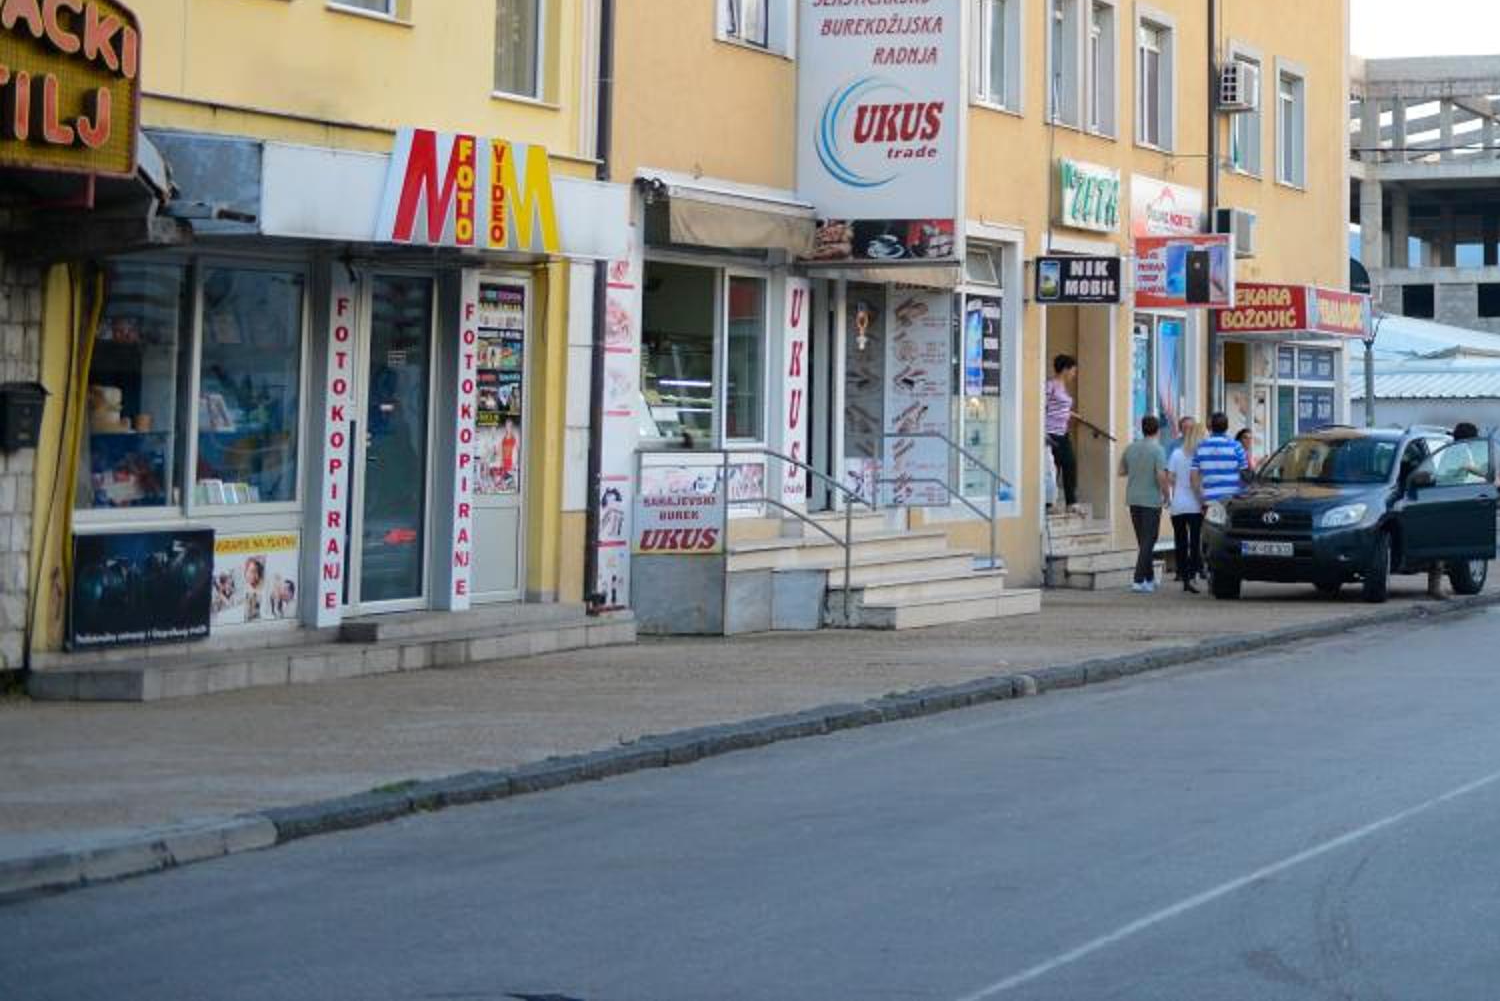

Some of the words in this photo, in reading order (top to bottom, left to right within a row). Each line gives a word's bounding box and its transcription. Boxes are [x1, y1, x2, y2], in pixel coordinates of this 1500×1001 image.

[820, 13, 943, 36] BUREKDŽIJSKA
[873, 46, 938, 65] RADNJA
[854, 101, 944, 143] UKUS
[887, 146, 937, 159] trade
[457, 138, 474, 240] FOTO
[490, 144, 505, 243] VIDEO
[1070, 261, 1109, 276] NIK
[1065, 280, 1117, 295] MOBIL
[1235, 287, 1291, 306] EKARA
[789, 288, 804, 478] UKUS
[323, 298, 349, 608] FOTOKOPIRANJE
[454, 303, 475, 596] FOTOKOPIRANJE
[640, 528, 719, 551] UKUS
